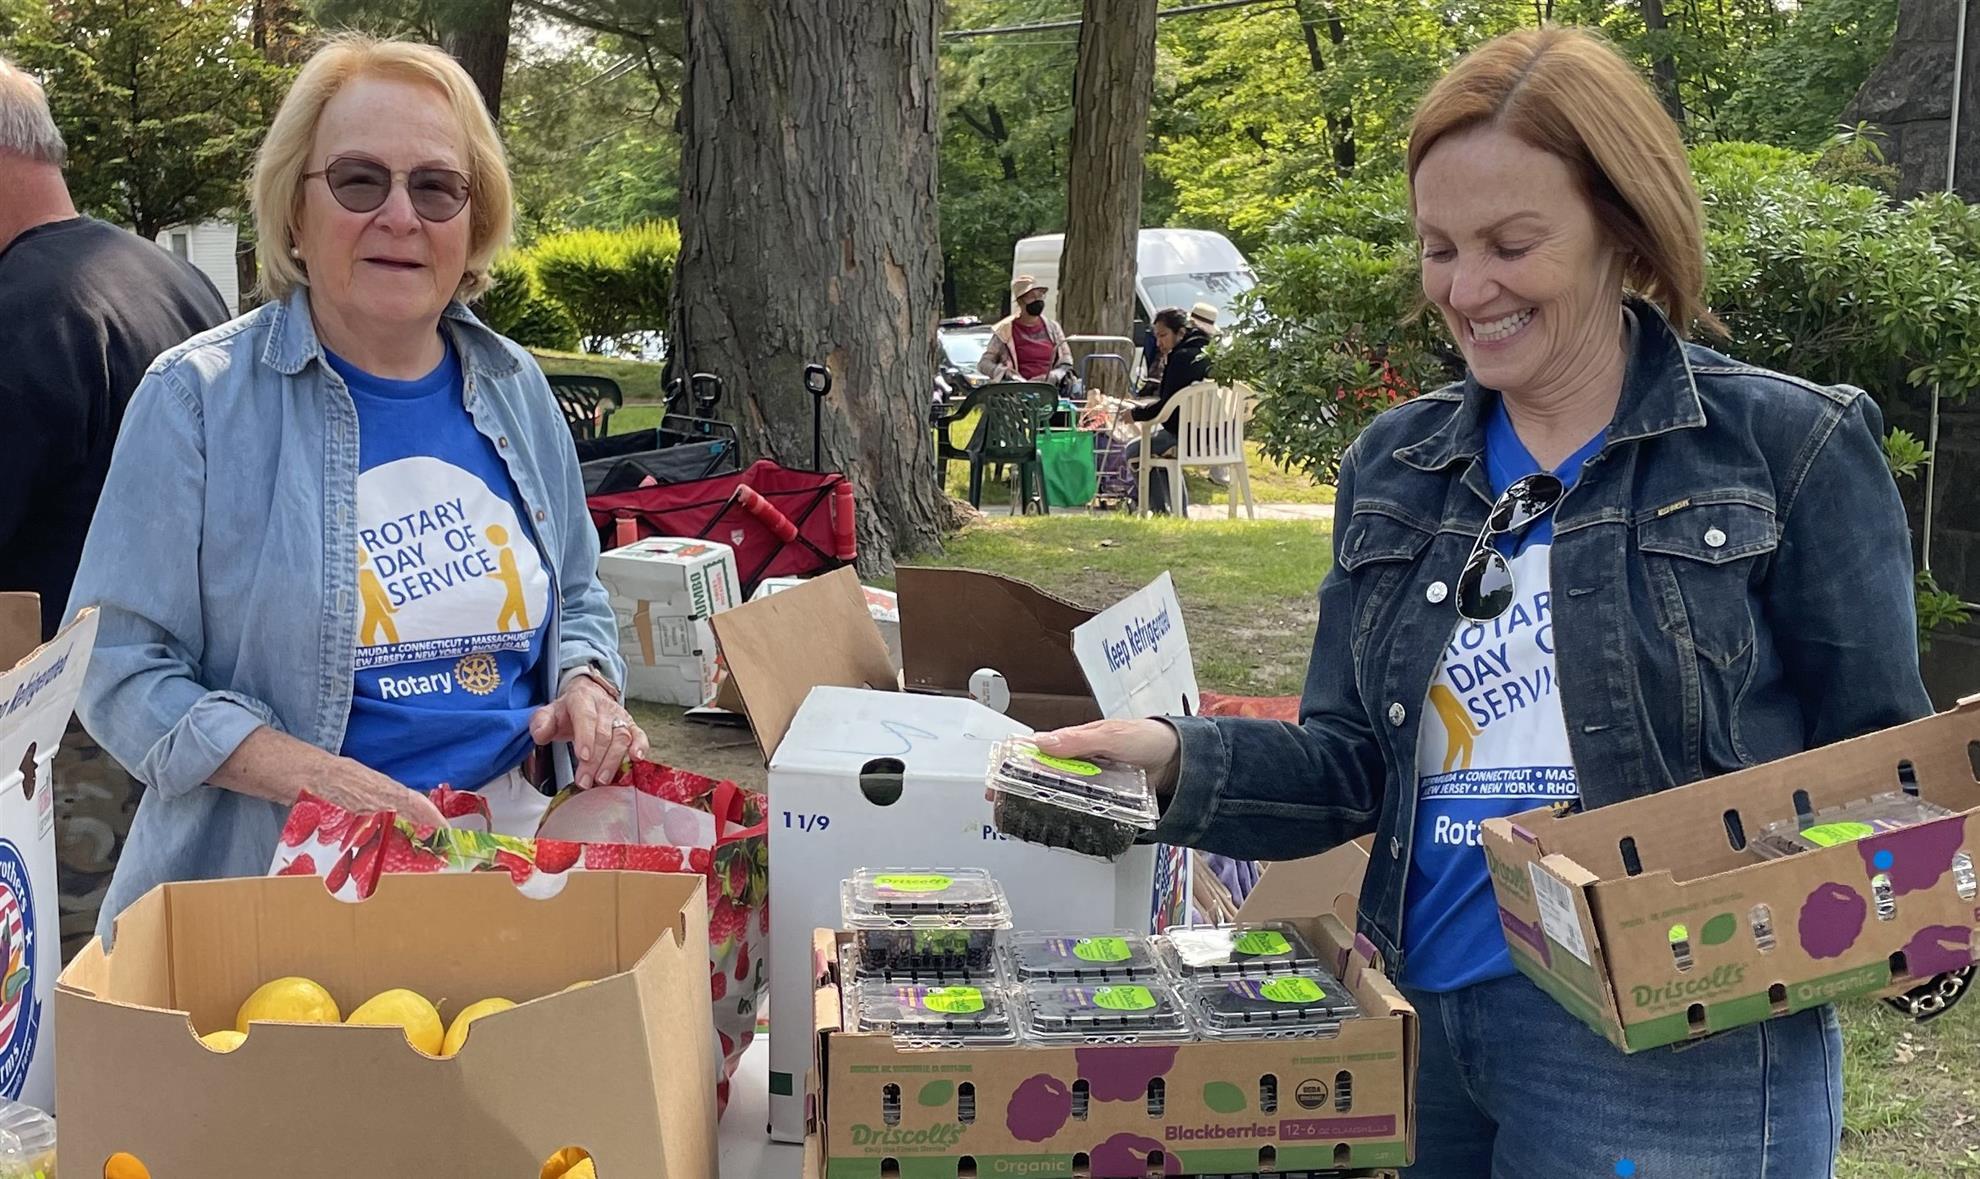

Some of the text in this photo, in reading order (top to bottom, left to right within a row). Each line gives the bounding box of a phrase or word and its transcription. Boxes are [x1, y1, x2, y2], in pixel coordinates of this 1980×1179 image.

[360, 498, 467, 553] ROTARY
[374, 525, 477, 580] DAY OF
[388, 549, 497, 608] SERVICE
[690, 571, 709, 622] JUMBO
[355, 657, 372, 667] EW
[373, 653, 406, 665] JERSEY
[415, 649, 438, 660] NEW
[398, 638, 463, 653] CONNECTICUT
[1101, 637, 1132, 673] Keep
[1446, 642, 1512, 694] DAY
[378, 672, 452, 700] Rotary
[1467, 666, 1552, 728] SERVI
[1440, 782, 1472, 794] JERSEY
[1479, 782, 1505, 794] NEW
[1505, 782, 1536, 794] YORK
[1466, 769, 1533, 782] CONNECTICUT
[1631, 962, 1747, 1007] Driscoll's
[1798, 970, 1878, 1001] Organic
[851, 1122, 962, 1147] Driscoll's
[1164, 1122, 1277, 1142] Blackberries
[1286, 1123, 1316, 1137] 12-6
[994, 1158, 1066, 1176] Organic
